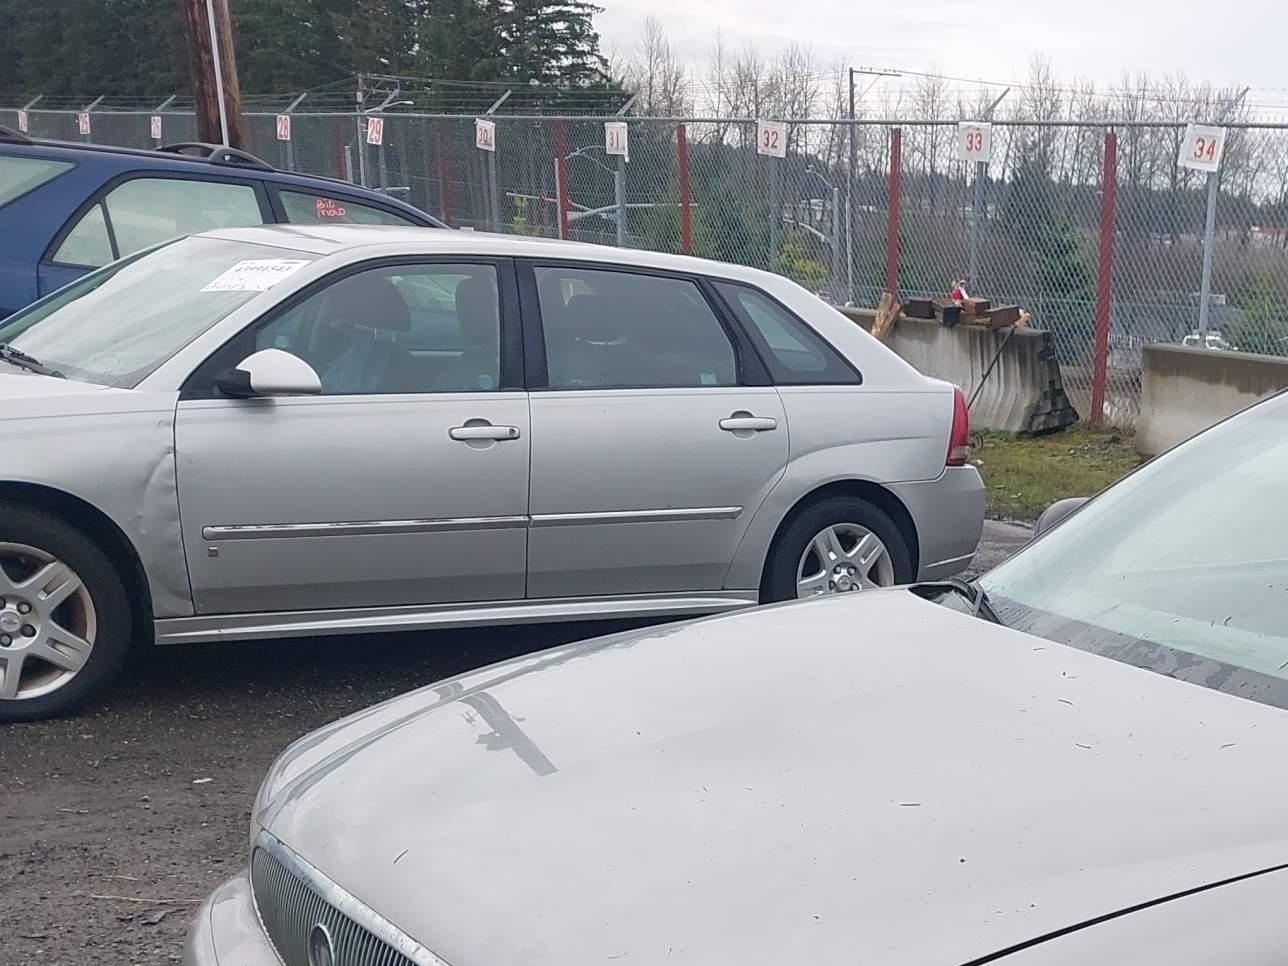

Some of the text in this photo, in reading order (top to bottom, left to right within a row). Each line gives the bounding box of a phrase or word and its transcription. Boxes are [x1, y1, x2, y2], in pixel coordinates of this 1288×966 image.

[279, 117, 288, 138] 28
[369, 119, 381, 143] 29
[478, 128, 488, 144] 30
[609, 131, 620, 149] 31
[763, 130, 779, 149] 32
[966, 132, 983, 151] 33
[1194, 137, 1217, 160] 34
